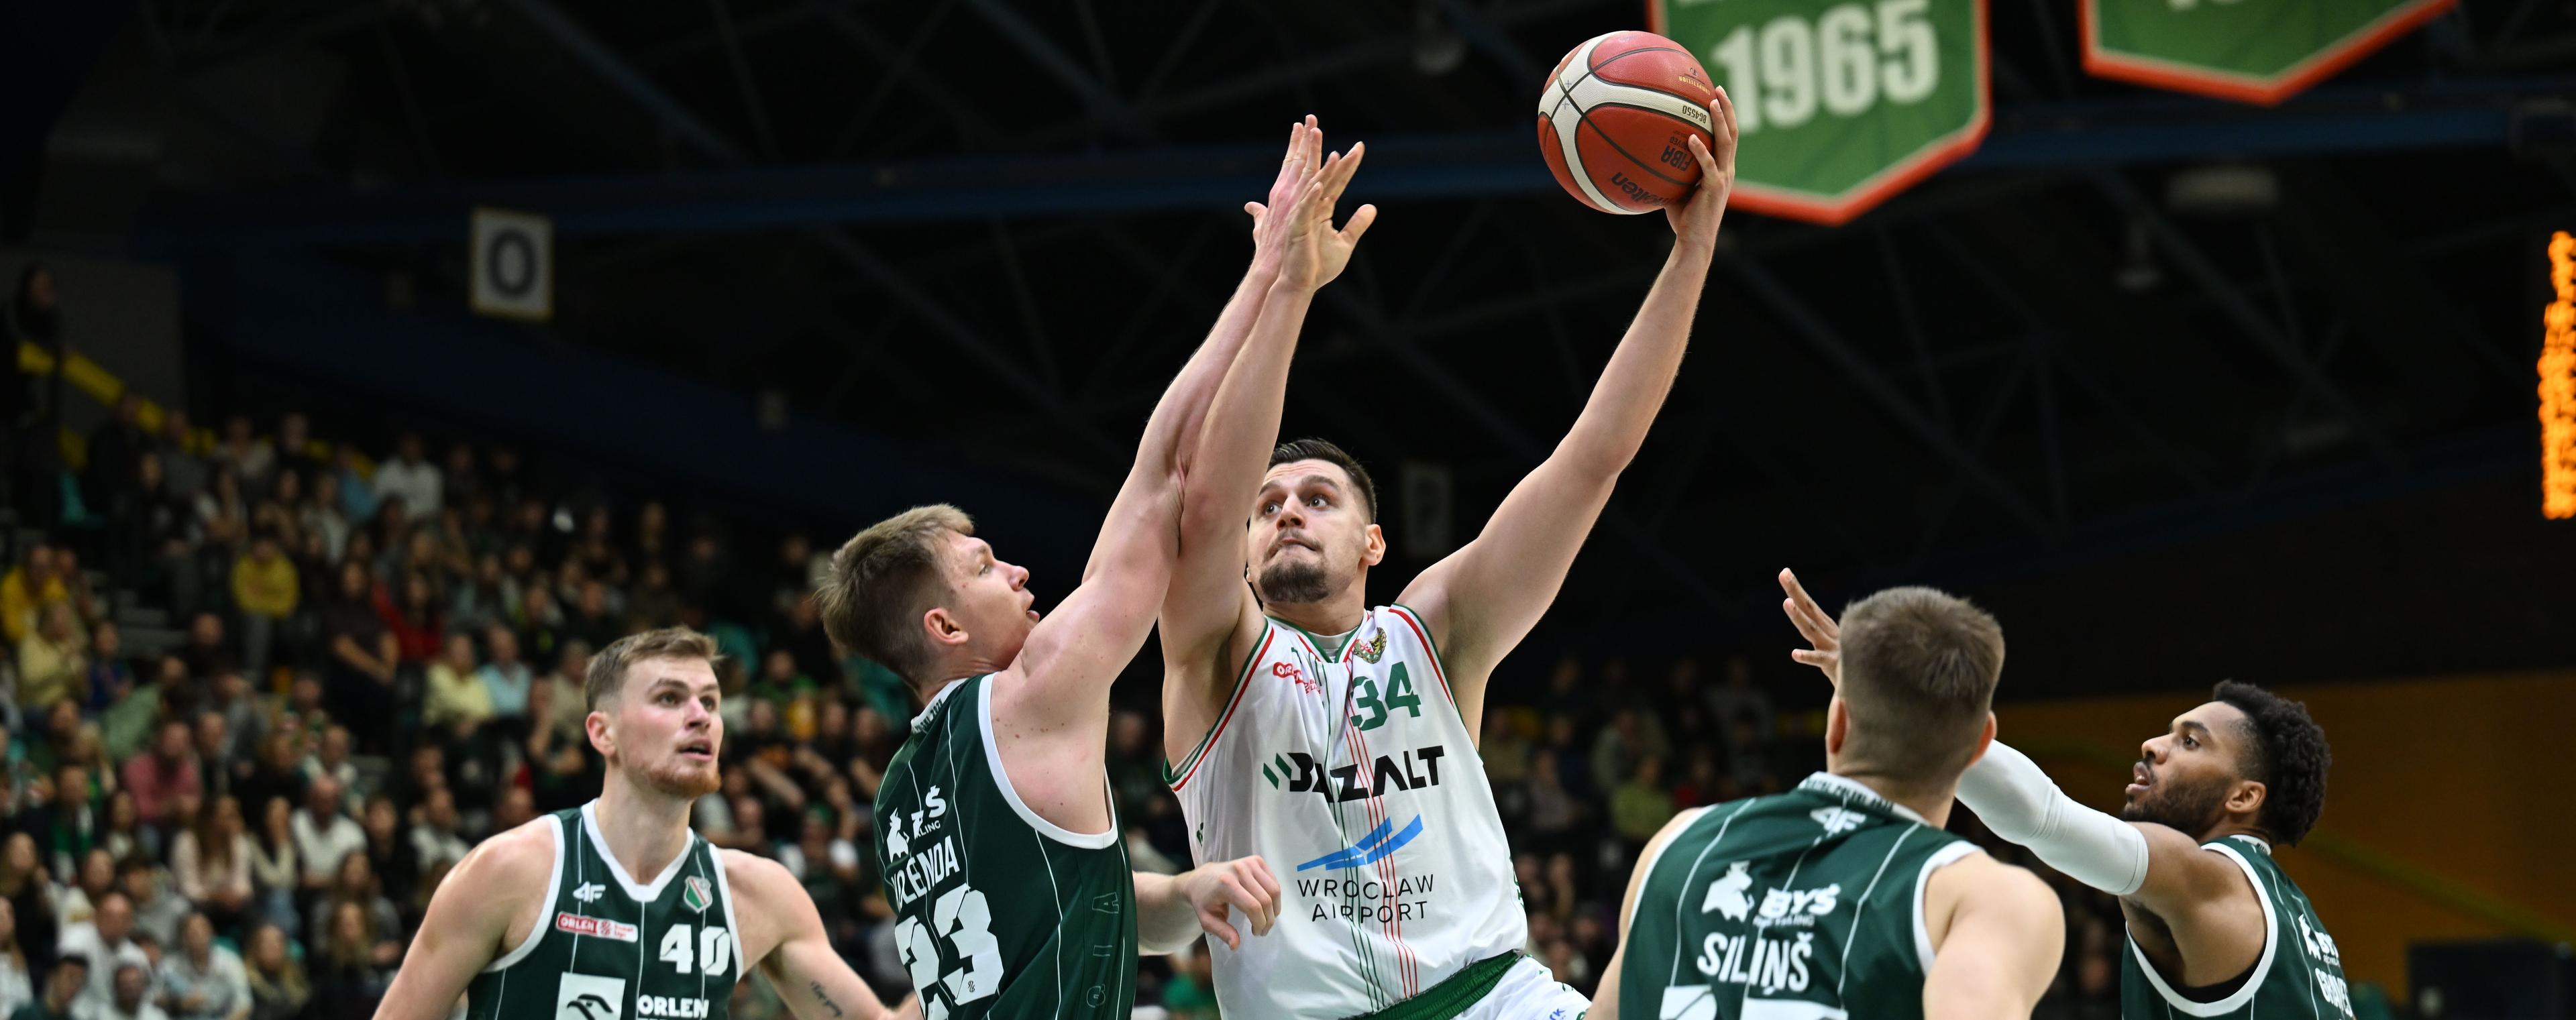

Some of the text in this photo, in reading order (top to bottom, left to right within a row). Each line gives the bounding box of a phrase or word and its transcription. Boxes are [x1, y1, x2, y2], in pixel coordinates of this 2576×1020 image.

[1711, 0, 1941, 133] 1965
[1682, 105, 1707, 125] BG4550
[1660, 145, 1695, 172] FIBA
[1351, 661, 1422, 732] 34
[1286, 745, 1445, 803] BAZALT
[1810, 807, 1867, 834] 4F
[572, 881, 606, 903] 4F
[1297, 874, 1434, 900] WROCLAW
[560, 916, 595, 932] ORLEN
[1311, 901, 1428, 924] AIRPORT
[659, 923, 732, 976] 40
[895, 883, 1005, 1020] 23
[1697, 931, 1814, 996] SILIŅŠ
[638, 995, 710, 1018] ORLEN
